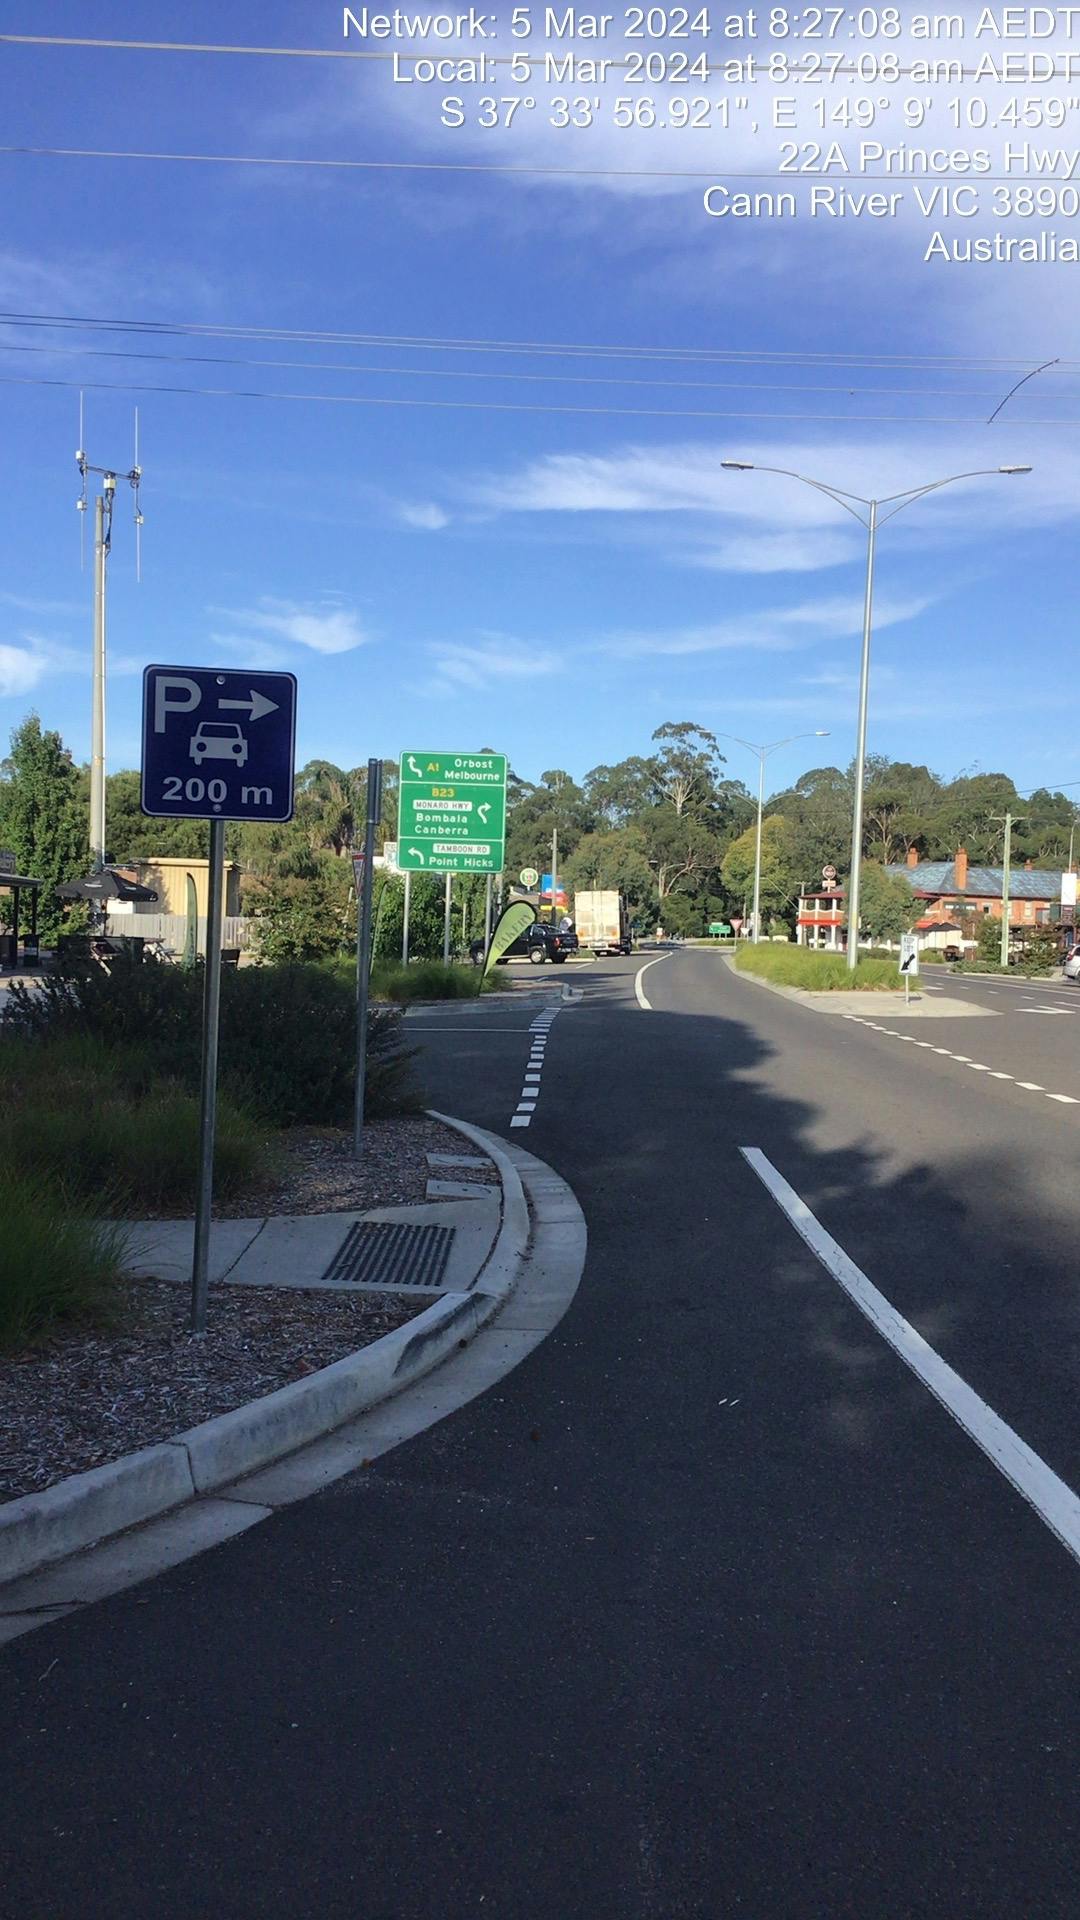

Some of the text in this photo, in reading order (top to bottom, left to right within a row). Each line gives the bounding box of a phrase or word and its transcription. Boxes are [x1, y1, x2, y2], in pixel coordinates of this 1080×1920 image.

[154, 675, 202, 733] P
[426, 762, 440, 772] A1
[454, 758, 493, 769] Orbost
[444, 770, 500, 781] Melbourne
[162, 776, 273, 805] 200 m
[431, 788, 455, 798] B23
[416, 801, 470, 810] MONARO HWY
[416, 813, 467, 823] Bombala
[414, 825, 469, 835] Canberra
[436, 844, 488, 853] TAMBOON RD
[428, 856, 494, 868] Point Hicks
[495, 914, 534, 952] BAKERY
